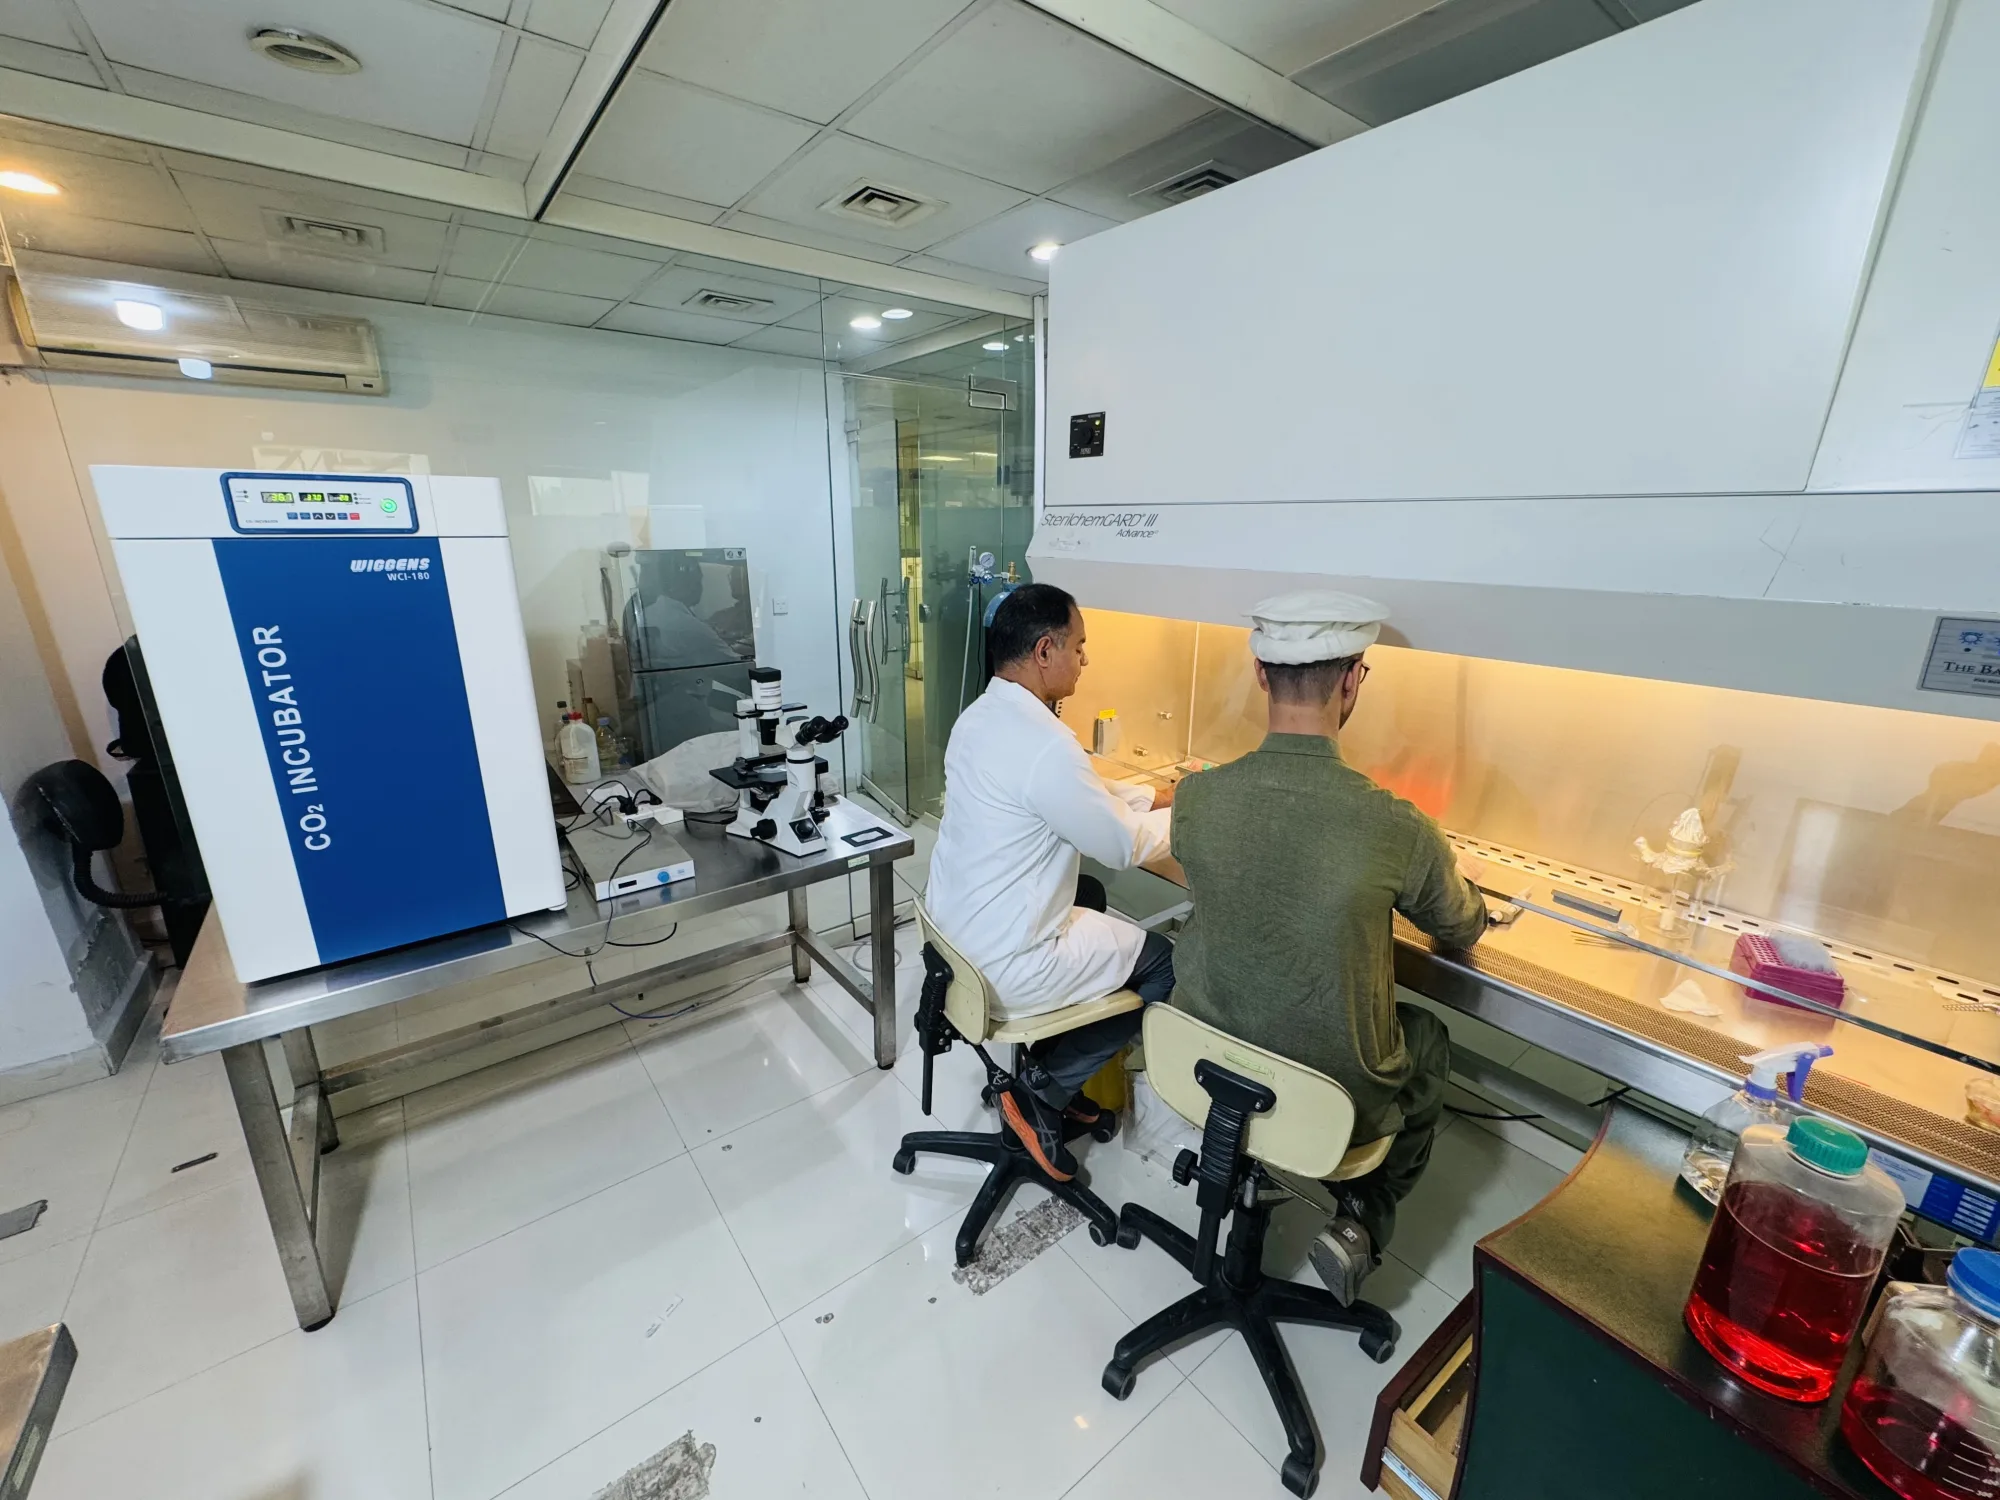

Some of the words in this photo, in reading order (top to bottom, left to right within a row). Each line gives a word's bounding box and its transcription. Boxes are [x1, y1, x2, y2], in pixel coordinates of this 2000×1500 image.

[1143, 513, 1159, 527] III
[350, 558, 430, 572] WIGGENS
[386, 572, 430, 581] WCI-180
[252, 624, 318, 795] INCUBATOR
